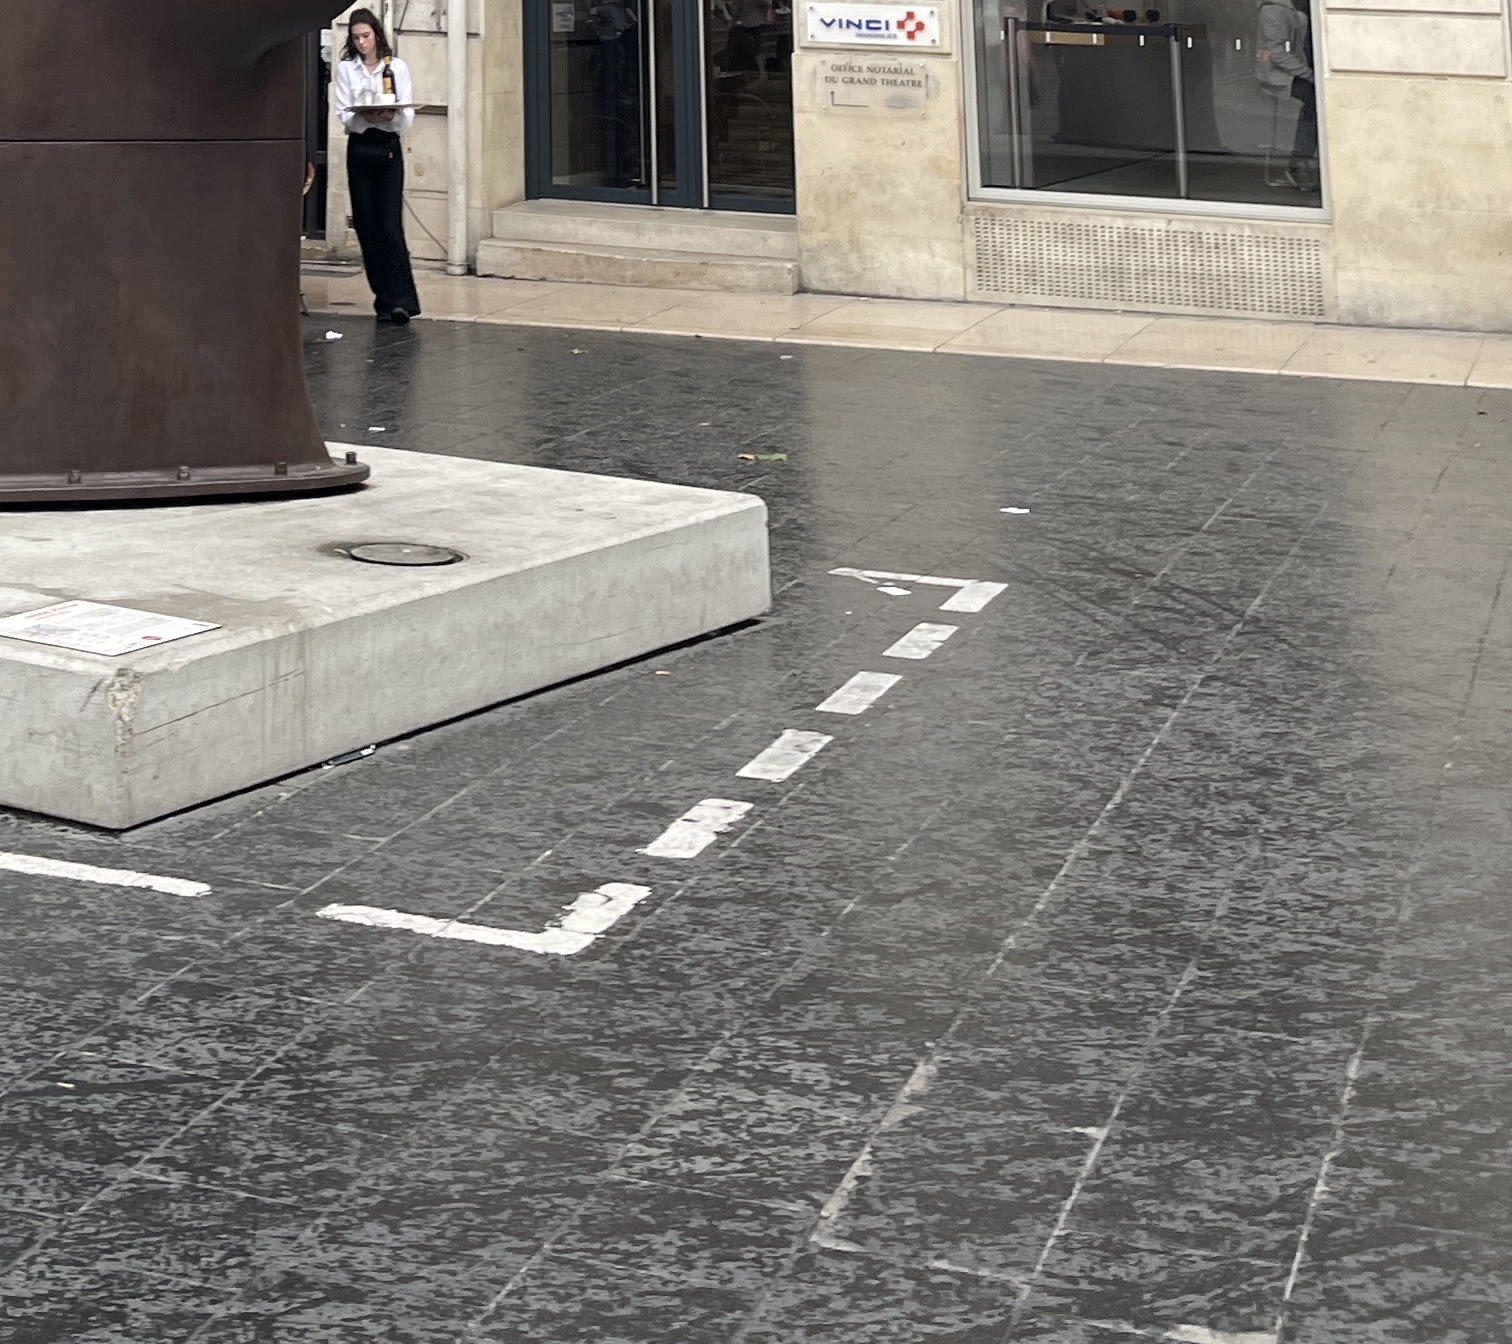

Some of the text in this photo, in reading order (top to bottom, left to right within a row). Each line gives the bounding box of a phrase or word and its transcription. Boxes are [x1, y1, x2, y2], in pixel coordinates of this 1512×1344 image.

[820, 18, 890, 31] VINCI
[830, 64, 915, 76] OFFICE NOTARIAL
[824, 75, 839, 84] DU
[841, 76, 878, 86] GRAND
